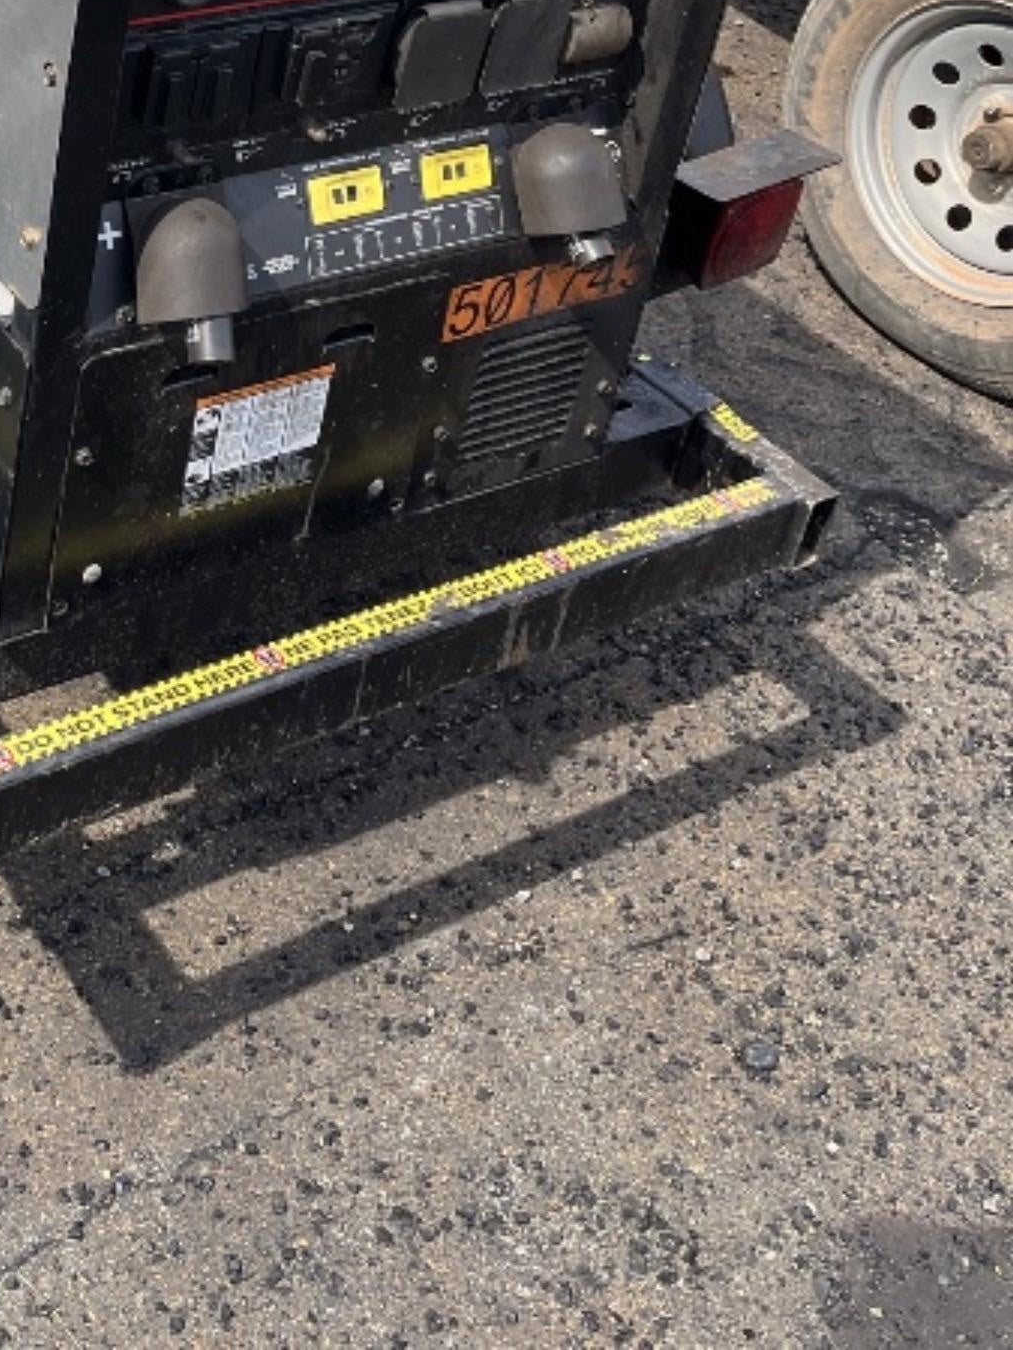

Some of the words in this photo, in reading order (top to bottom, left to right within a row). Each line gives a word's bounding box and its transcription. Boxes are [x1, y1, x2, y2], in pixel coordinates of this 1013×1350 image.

[16, 733, 52, 755] DO
[55, 712, 107, 741] NOT
[111, 682, 190, 721] STAND
[192, 660, 258, 691] HERE
